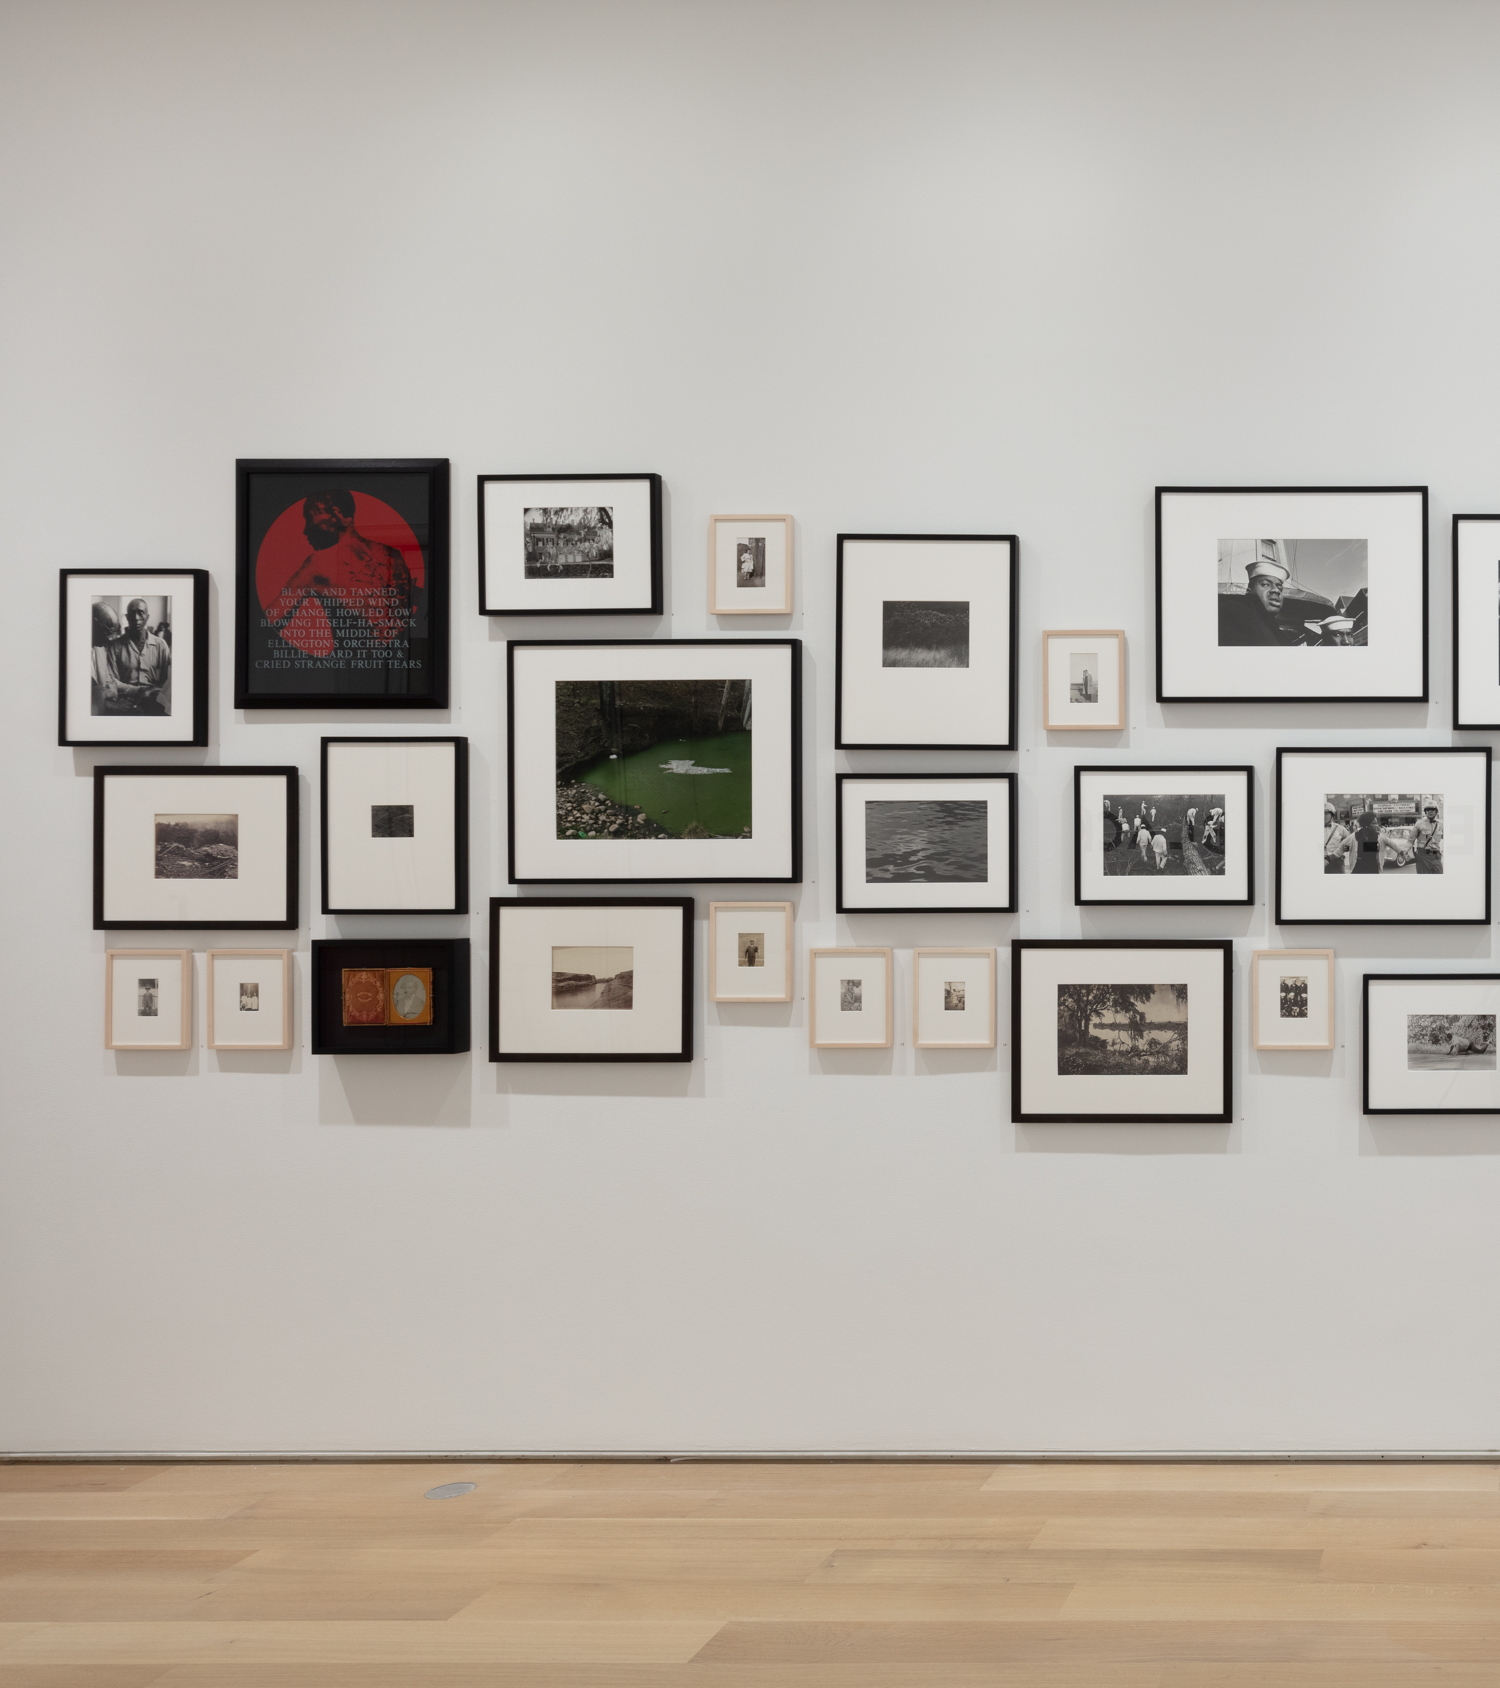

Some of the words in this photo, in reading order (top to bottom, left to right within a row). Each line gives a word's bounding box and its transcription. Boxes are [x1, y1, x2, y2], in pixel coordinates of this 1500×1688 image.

[281, 588, 318, 596] BLACK
[322, 588, 347, 596] AND
[350, 588, 397, 596] TANNED
[280, 598, 310, 606] YOUR
[313, 598, 365, 606] WHIPPED
[368, 598, 399, 606] WIND
[265, 608, 280, 617] OF
[284, 608, 332, 617] CHANGE
[336, 608, 384, 617] HOWLED
[388, 608, 412, 617] LOW
[260, 618, 311, 627] BLOWING
[279, 629, 306, 637] INTO
[309, 629, 331, 637] THE
[335, 629, 380, 637] MIDDLE
[384, 629, 399, 637] OF
[268, 639, 339, 648] ELLINGTON'S
[343, 639, 410, 648] ORCHESTRA
[273, 649, 309, 658] BILLIE
[313, 649, 353, 658] HEARD
[357, 649, 368, 658] IT
[371, 649, 393, 658] TOO
[396, 649, 404, 658] &
[255, 660, 291, 669] CRIED
[294, 660, 346, 669] STRANGE
[351, 660, 383, 669] FRUIT
[387, 660, 422, 669] TEARS
